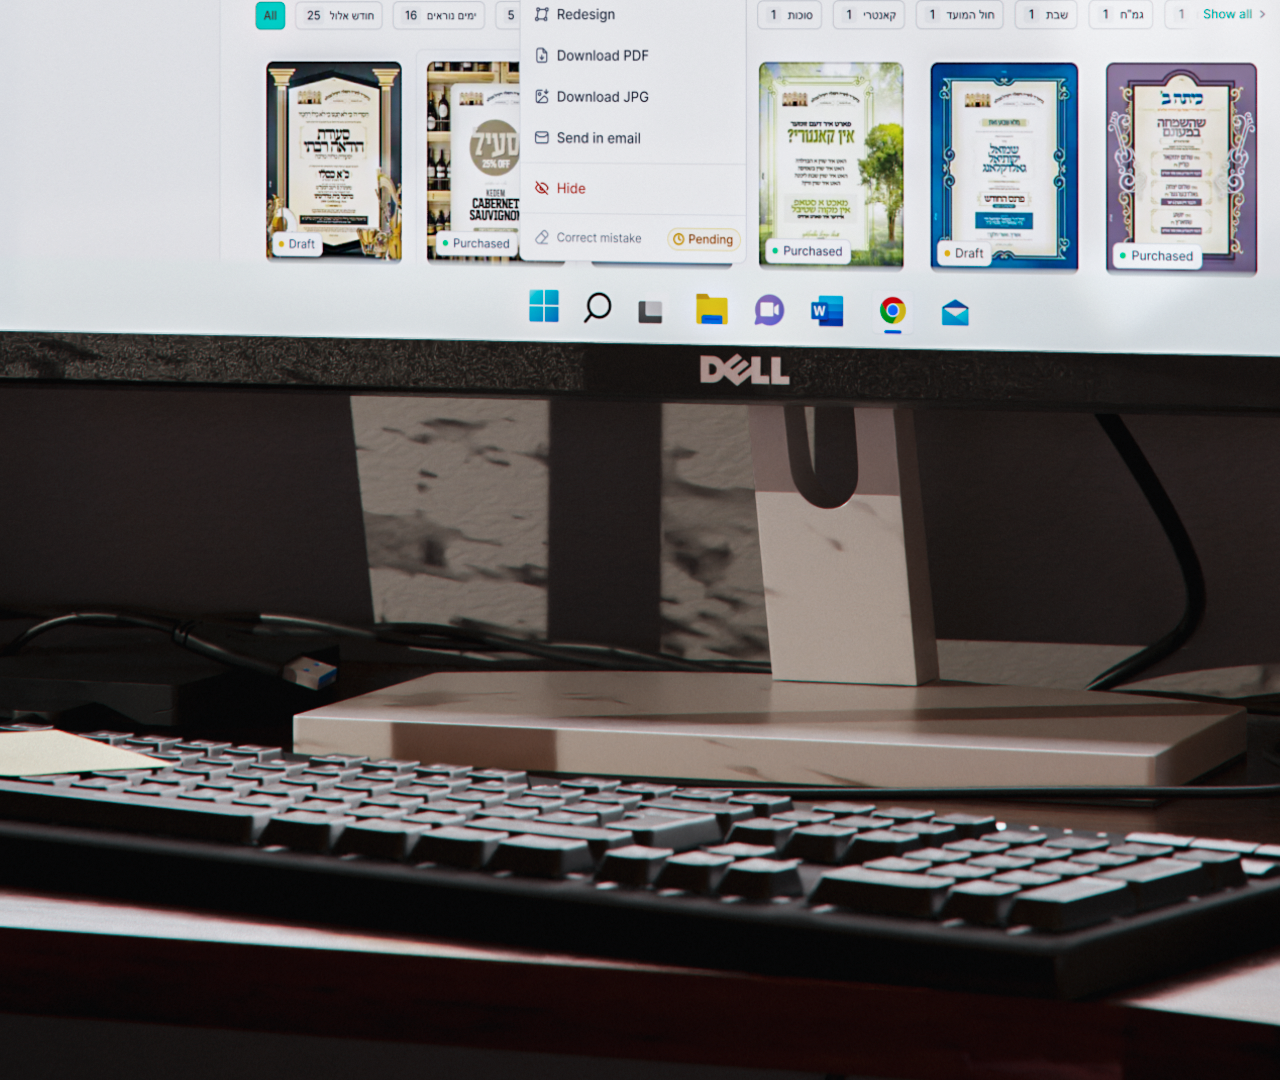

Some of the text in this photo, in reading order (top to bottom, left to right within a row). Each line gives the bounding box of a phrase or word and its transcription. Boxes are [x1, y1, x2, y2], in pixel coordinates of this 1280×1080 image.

[263, 10, 278, 21] All
[306, 8, 375, 21] 25 חודש אלול
[404, 10, 477, 21] 16 ימים נוראים
[507, 10, 515, 21] 5
[557, 8, 616, 23] Redesign
[770, 10, 813, 21] 1 סוכות
[846, 10, 897, 23] 1 קאנטרי
[929, 8, 995, 21] 1 חול המועד
[1028, 10, 1068, 21] 1 שבת
[1103, 9, 1144, 21] 1 גמ"ח
[1203, 8, 1252, 21] Show all
[557, 49, 649, 62] Download PDF
[557, 90, 649, 103] Download JPG
[1173, 92, 1203, 105] כיתה
[1157, 119, 1207, 128] שהשמחה
[557, 132, 641, 145] Send in email
[787, 128, 855, 145] אין קאנטרי?
[482, 159, 511, 169] 25% OFF
[557, 182, 586, 195] Hide
[472, 197, 520, 209] CABERNET
[288, 238, 315, 249] Draft
[453, 238, 510, 249] Purchased
[557, 232, 642, 245] Correct mistake
[688, 233, 734, 248] Pending
[783, 245, 843, 257] Purchased
[955, 247, 984, 259] Draft
[1132, 250, 1194, 262] Purchased
[813, 305, 826, 317] W
[700, 353, 790, 387] DELL
